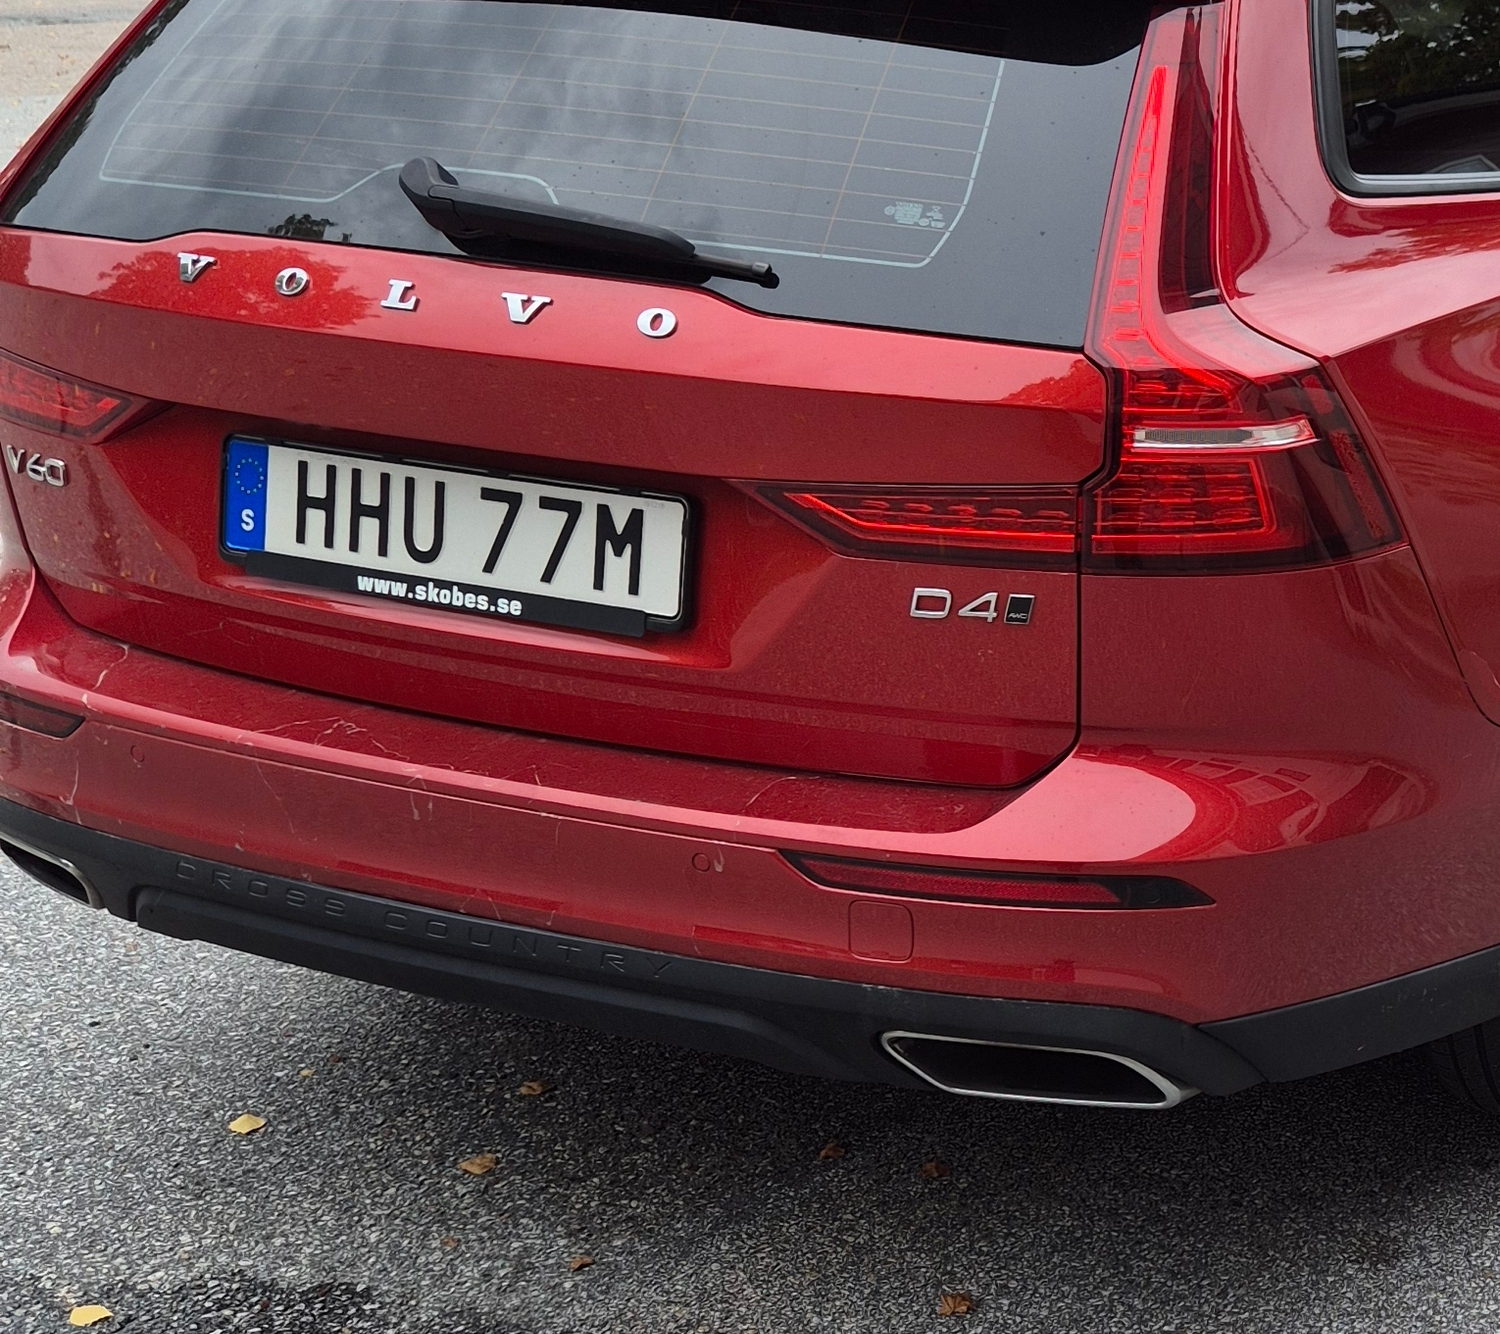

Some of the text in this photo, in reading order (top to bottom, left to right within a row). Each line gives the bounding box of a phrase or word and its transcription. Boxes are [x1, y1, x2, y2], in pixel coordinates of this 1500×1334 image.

[177, 252, 677, 338] VOLVO
[6, 444, 67, 487] V60
[240, 508, 255, 532] S
[296, 459, 645, 596] HHU 77M
[357, 574, 523, 616] www.skobes.se
[910, 587, 999, 622] D4
[174, 860, 674, 979] CROSS COUNTRY
